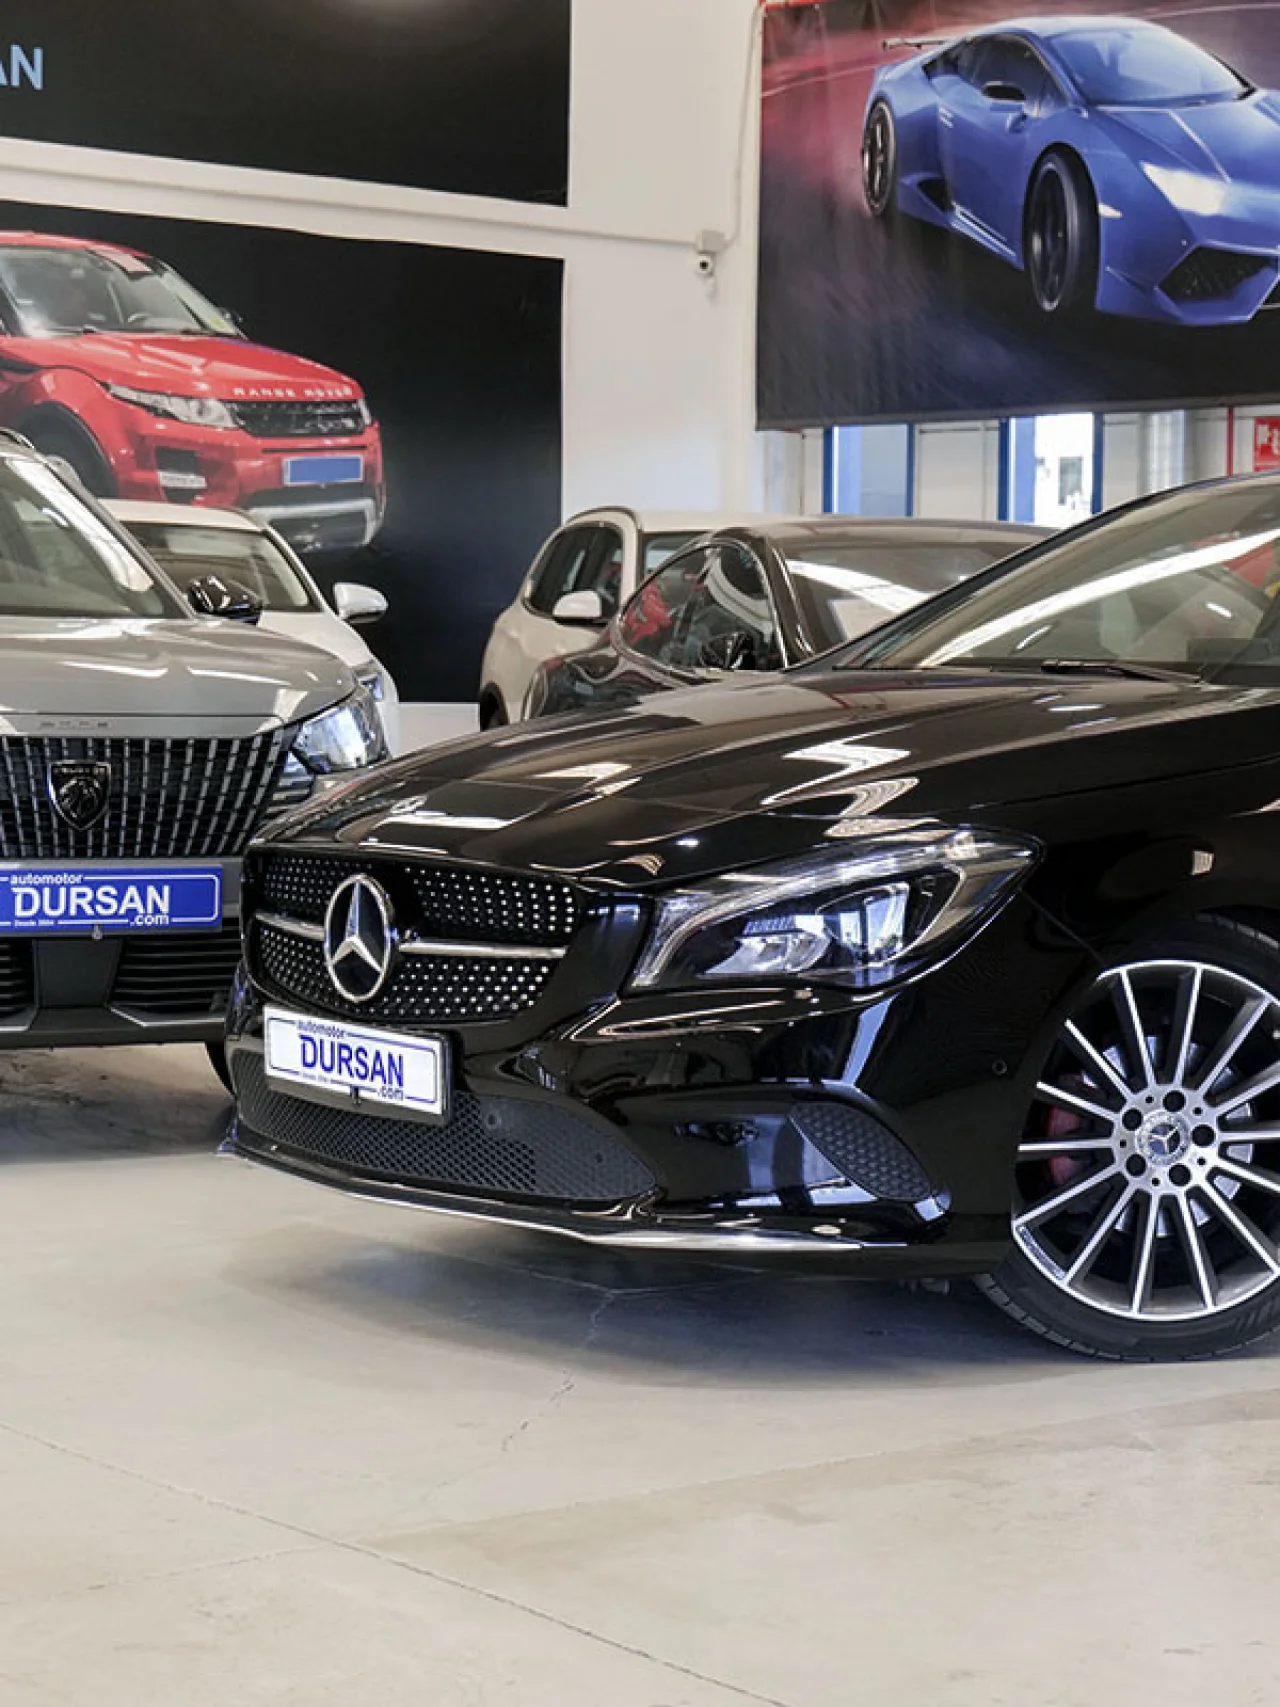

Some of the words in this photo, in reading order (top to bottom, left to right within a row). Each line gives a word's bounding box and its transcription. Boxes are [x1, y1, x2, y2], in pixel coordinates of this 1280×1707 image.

[0, 44, 43, 90] N
[10, 873, 83, 884] automotor
[11, 885, 170, 917] DURSAN
[299, 1034, 404, 1087] DURSAN
